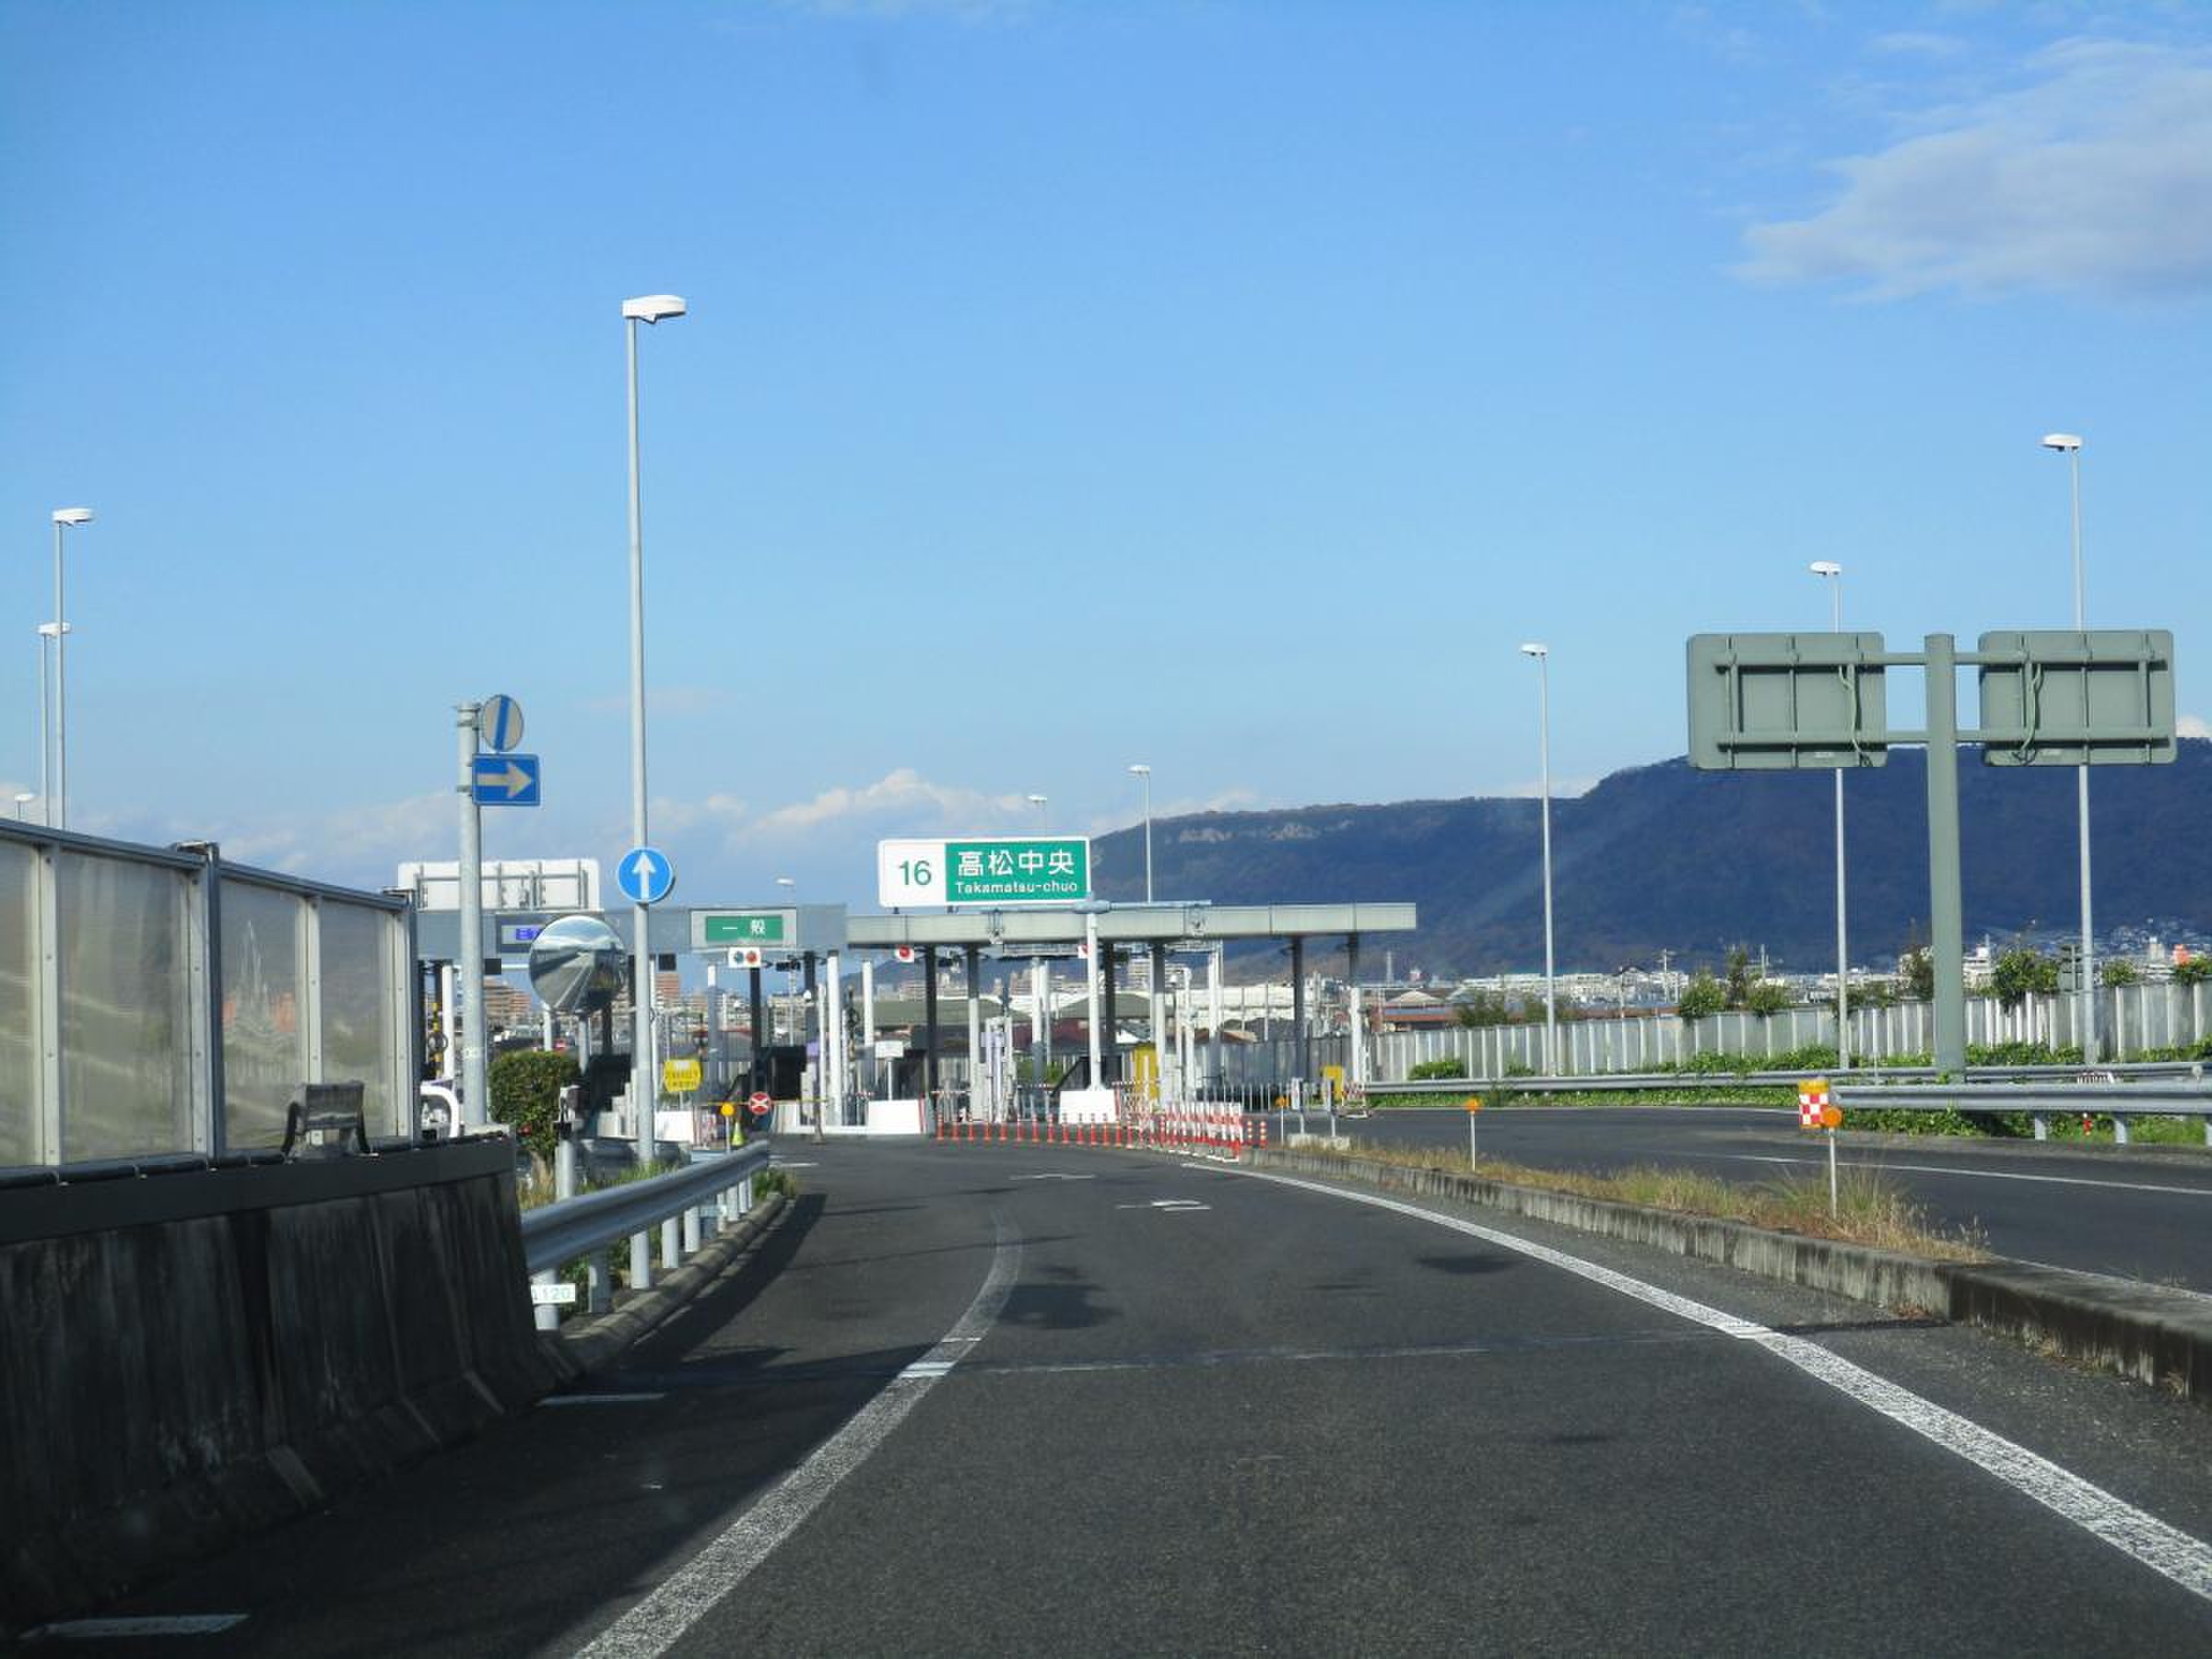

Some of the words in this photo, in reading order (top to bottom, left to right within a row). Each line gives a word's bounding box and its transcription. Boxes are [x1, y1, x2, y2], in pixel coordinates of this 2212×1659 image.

[899, 860, 932, 886] 16
[958, 850, 1075, 876] 高松中央
[955, 881, 1077, 894] Takamatsu-chuo
[722, 919, 766, 937] 一般
